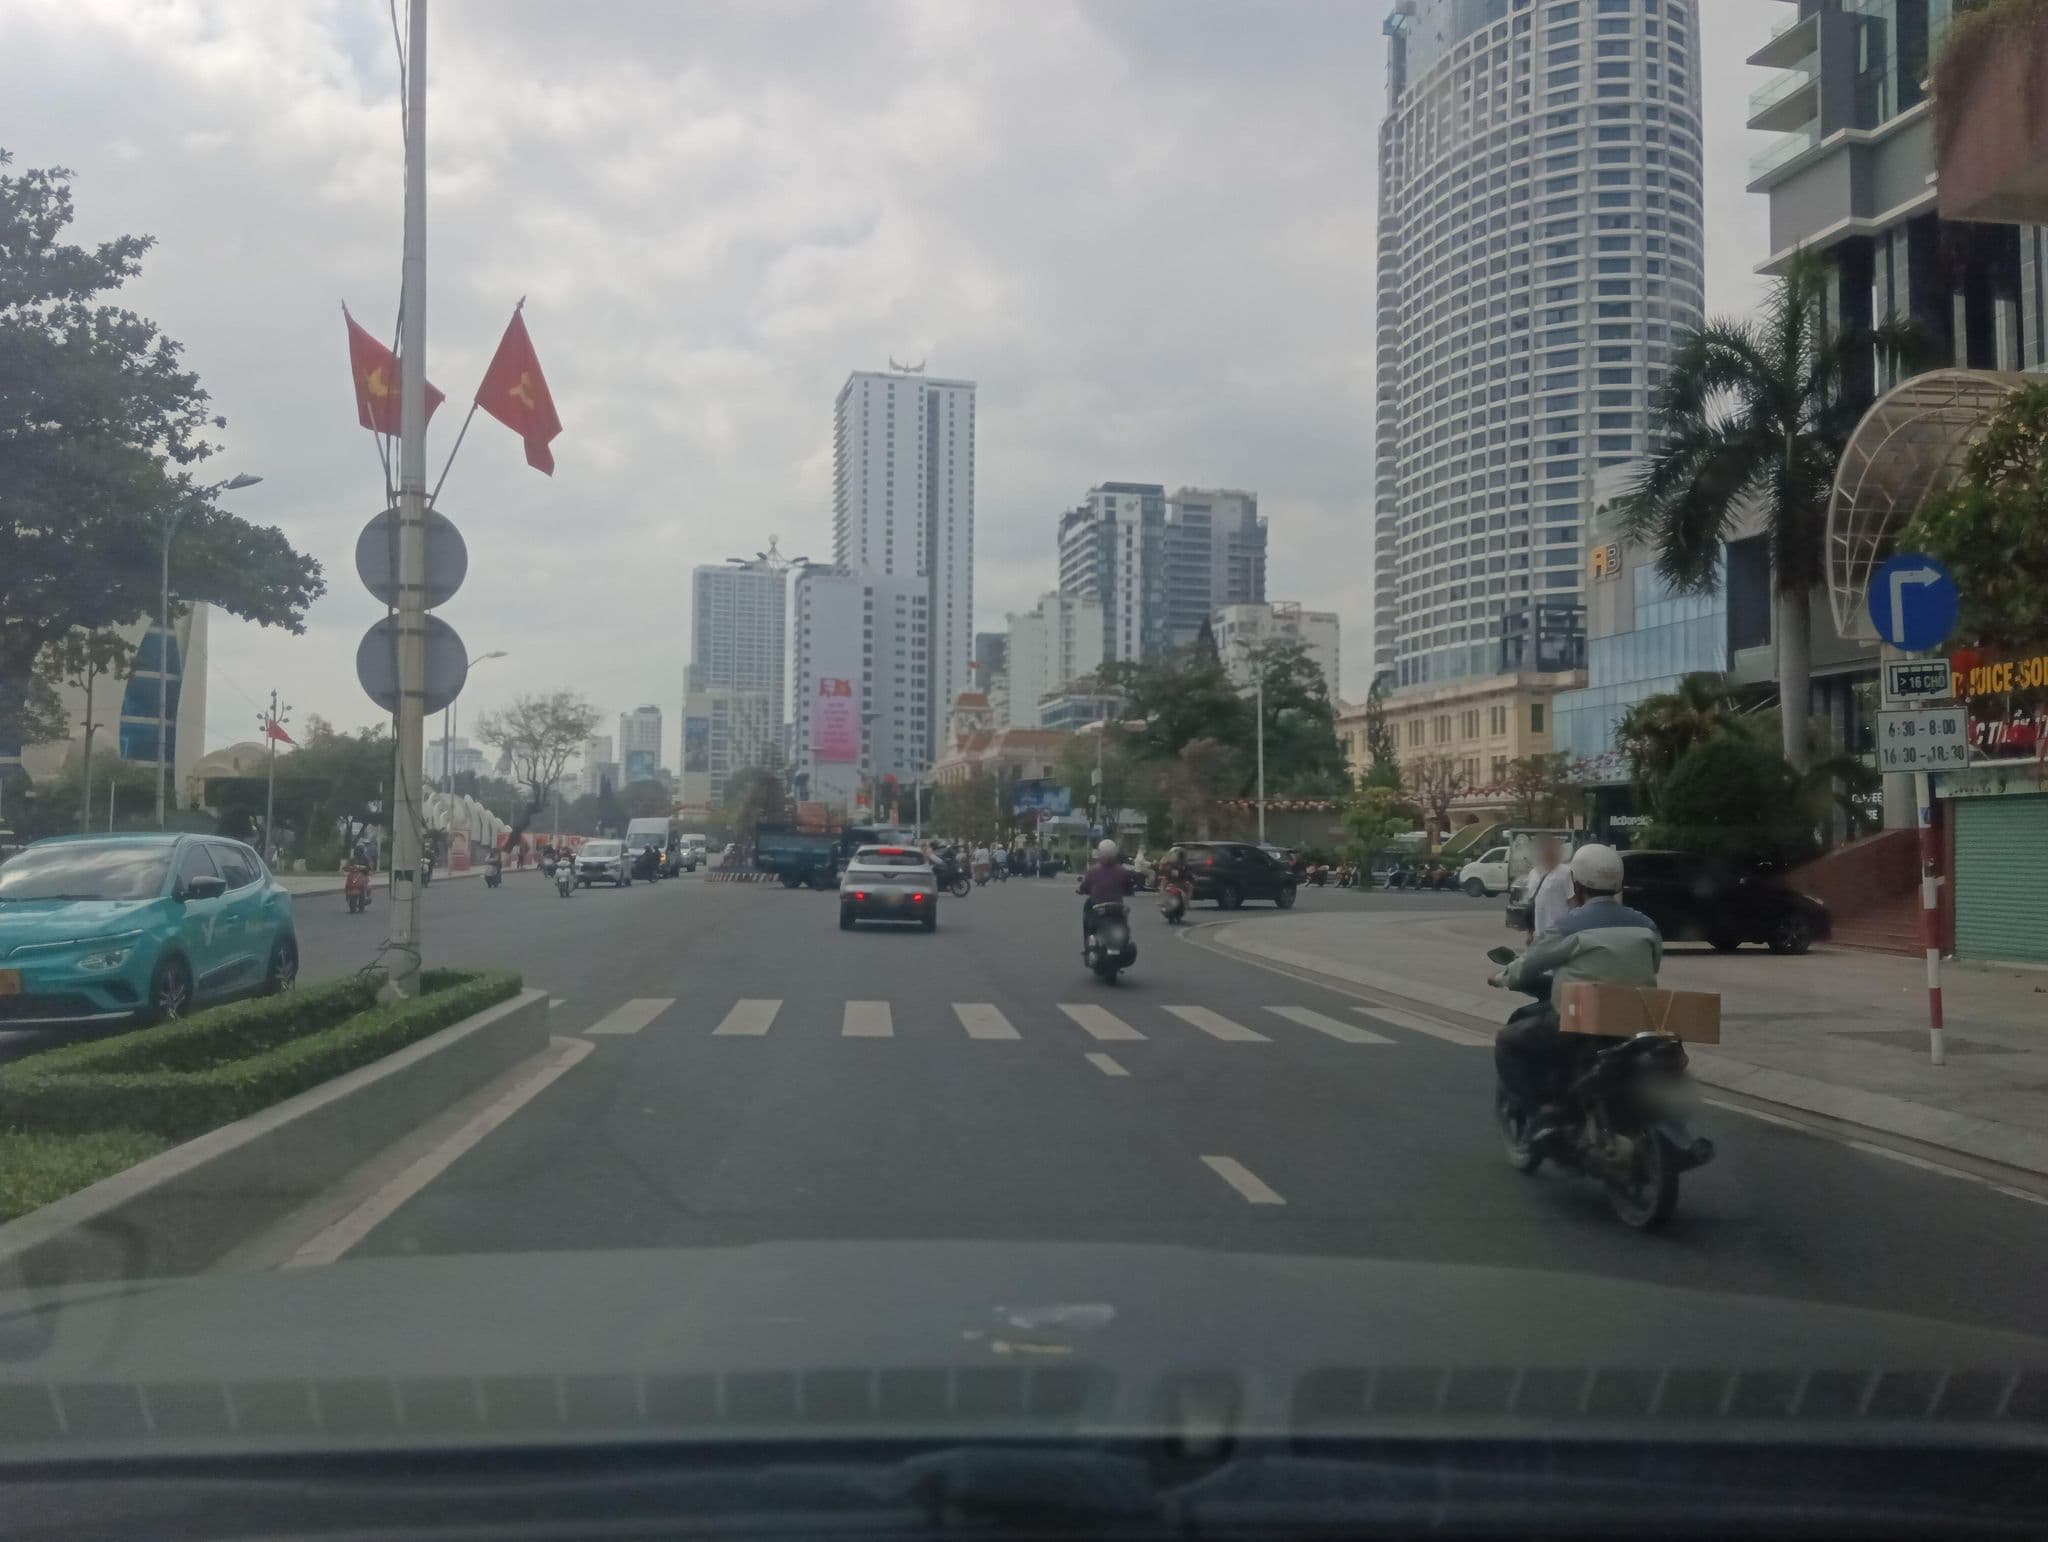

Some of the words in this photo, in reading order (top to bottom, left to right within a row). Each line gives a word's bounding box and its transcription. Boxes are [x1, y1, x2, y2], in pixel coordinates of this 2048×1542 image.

[1909, 676, 1922, 689] 16
[1888, 720, 1916, 738] 6:30
[1929, 719, 1956, 735] 8:00
[1883, 746, 1917, 765] 1630
